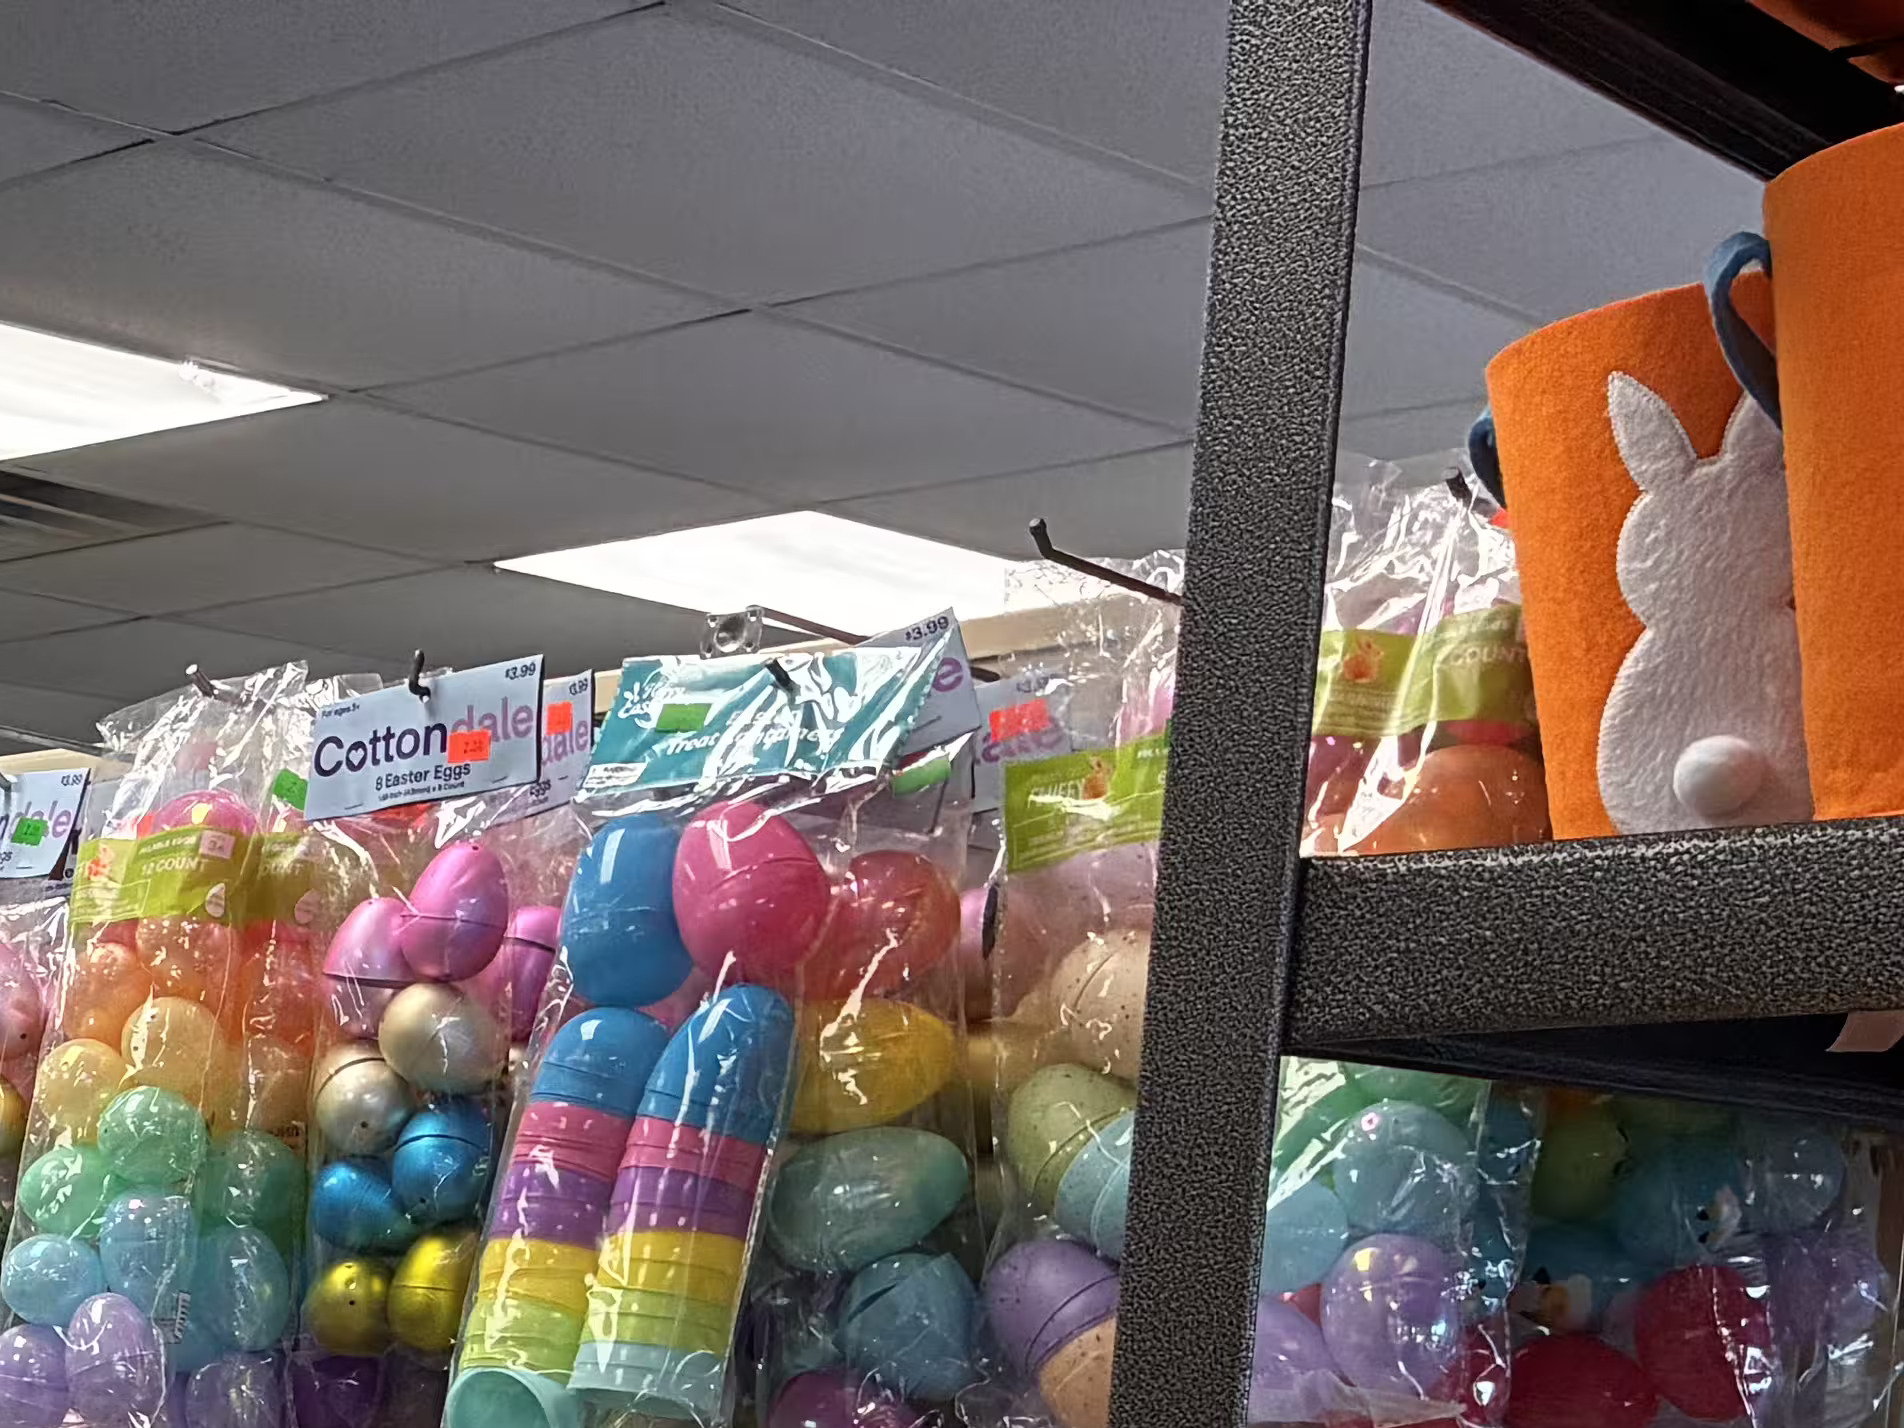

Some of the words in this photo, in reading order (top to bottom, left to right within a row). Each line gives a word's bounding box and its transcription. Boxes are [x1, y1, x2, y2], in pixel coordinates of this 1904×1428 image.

[505, 663, 535, 679] $3.99
[376, 776, 382, 791] 8
[384, 771, 430, 789] Easter
[434, 762, 471, 780] Eggs
[156, 857, 207, 872] COUNT
